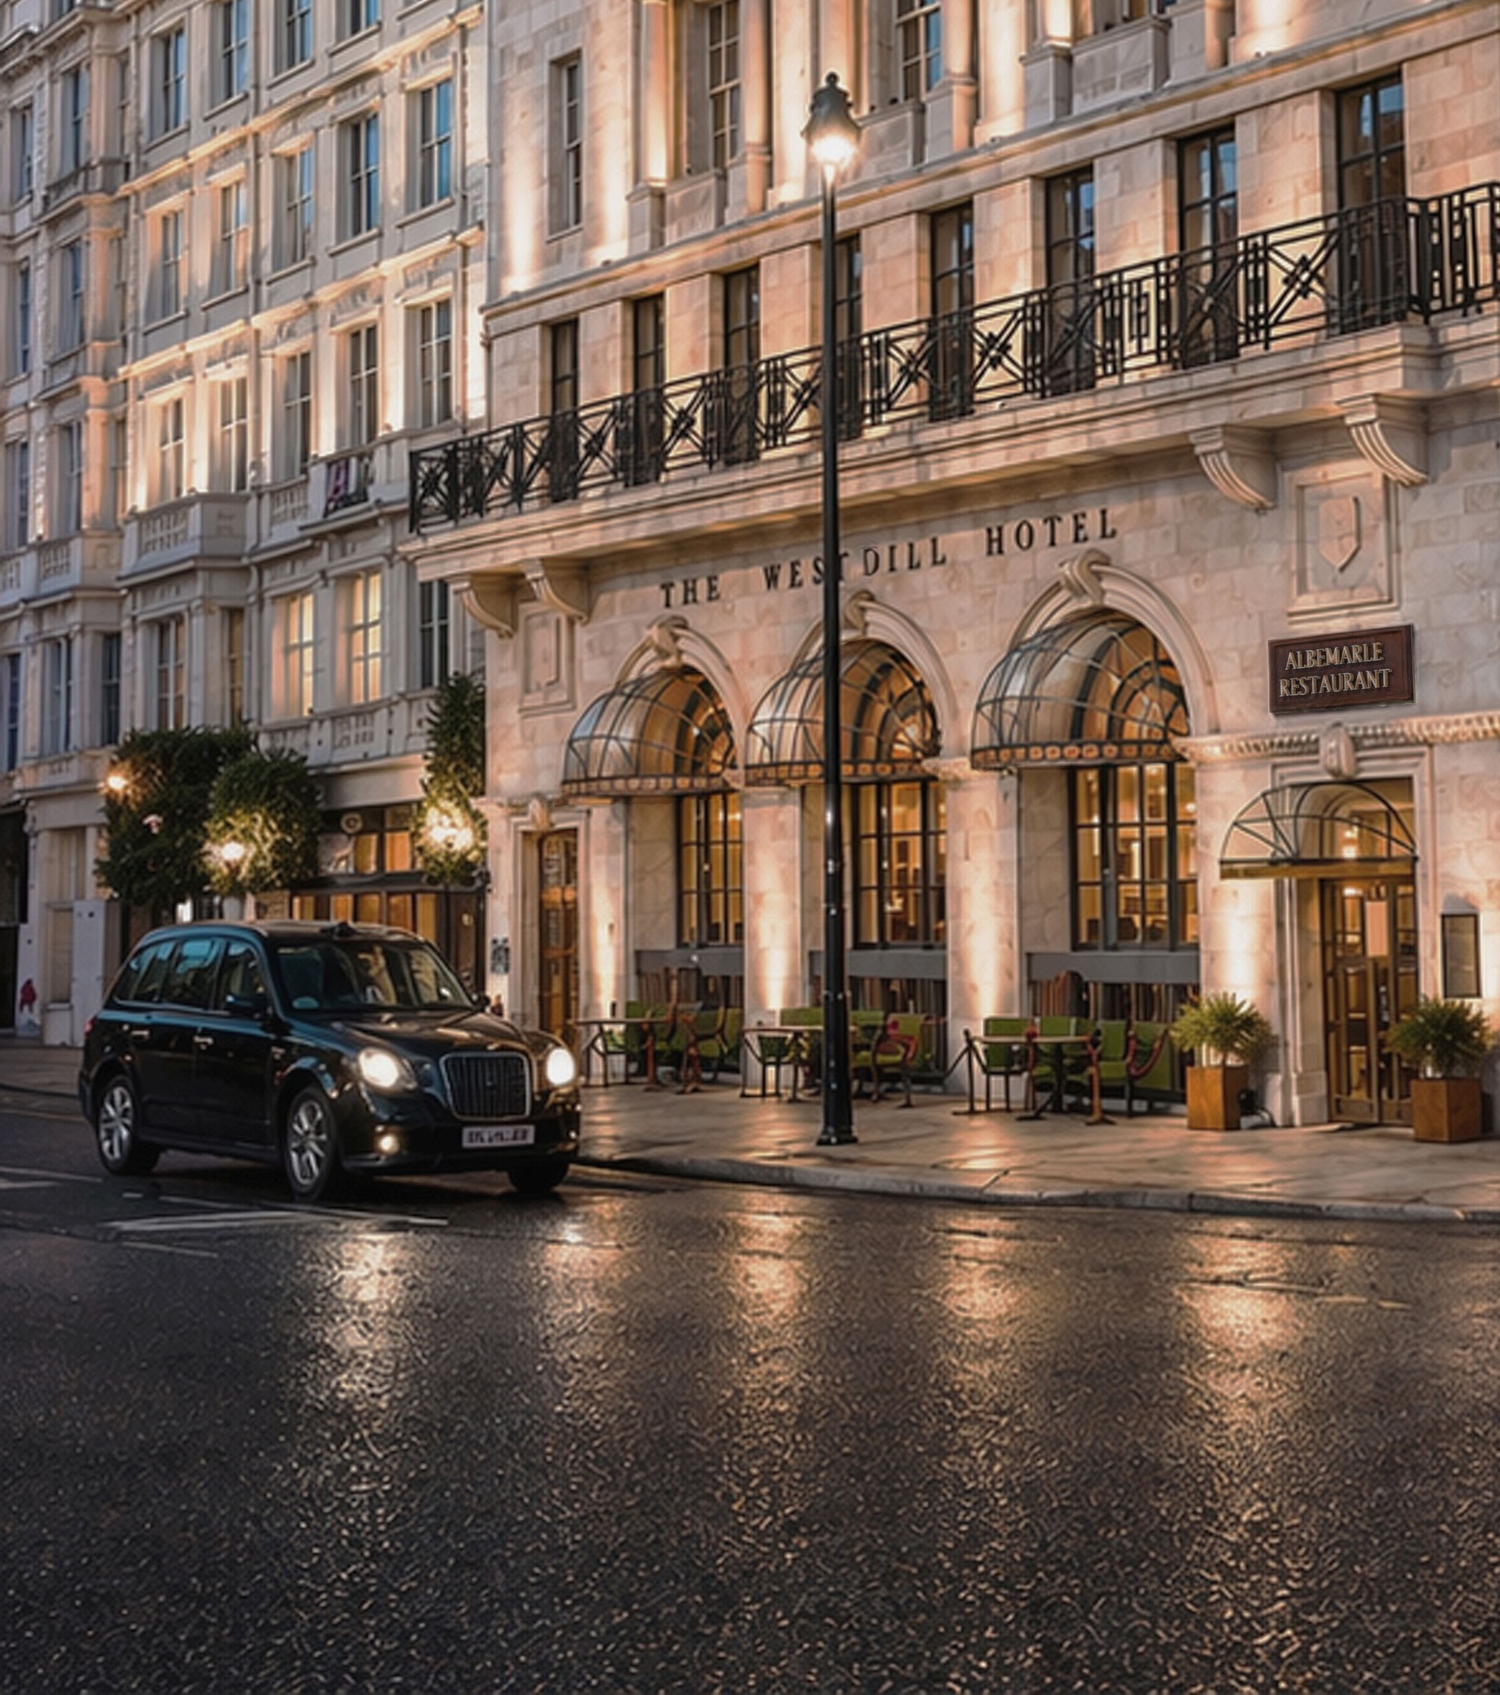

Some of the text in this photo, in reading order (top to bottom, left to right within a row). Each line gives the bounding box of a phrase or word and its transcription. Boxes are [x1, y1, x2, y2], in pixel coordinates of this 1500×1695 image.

[660, 576, 721, 608] THE
[985, 508, 1117, 556] HOTEL
[1285, 642, 1384, 670] ALBEMARLE
[1279, 668, 1392, 697] RESTAURANT
